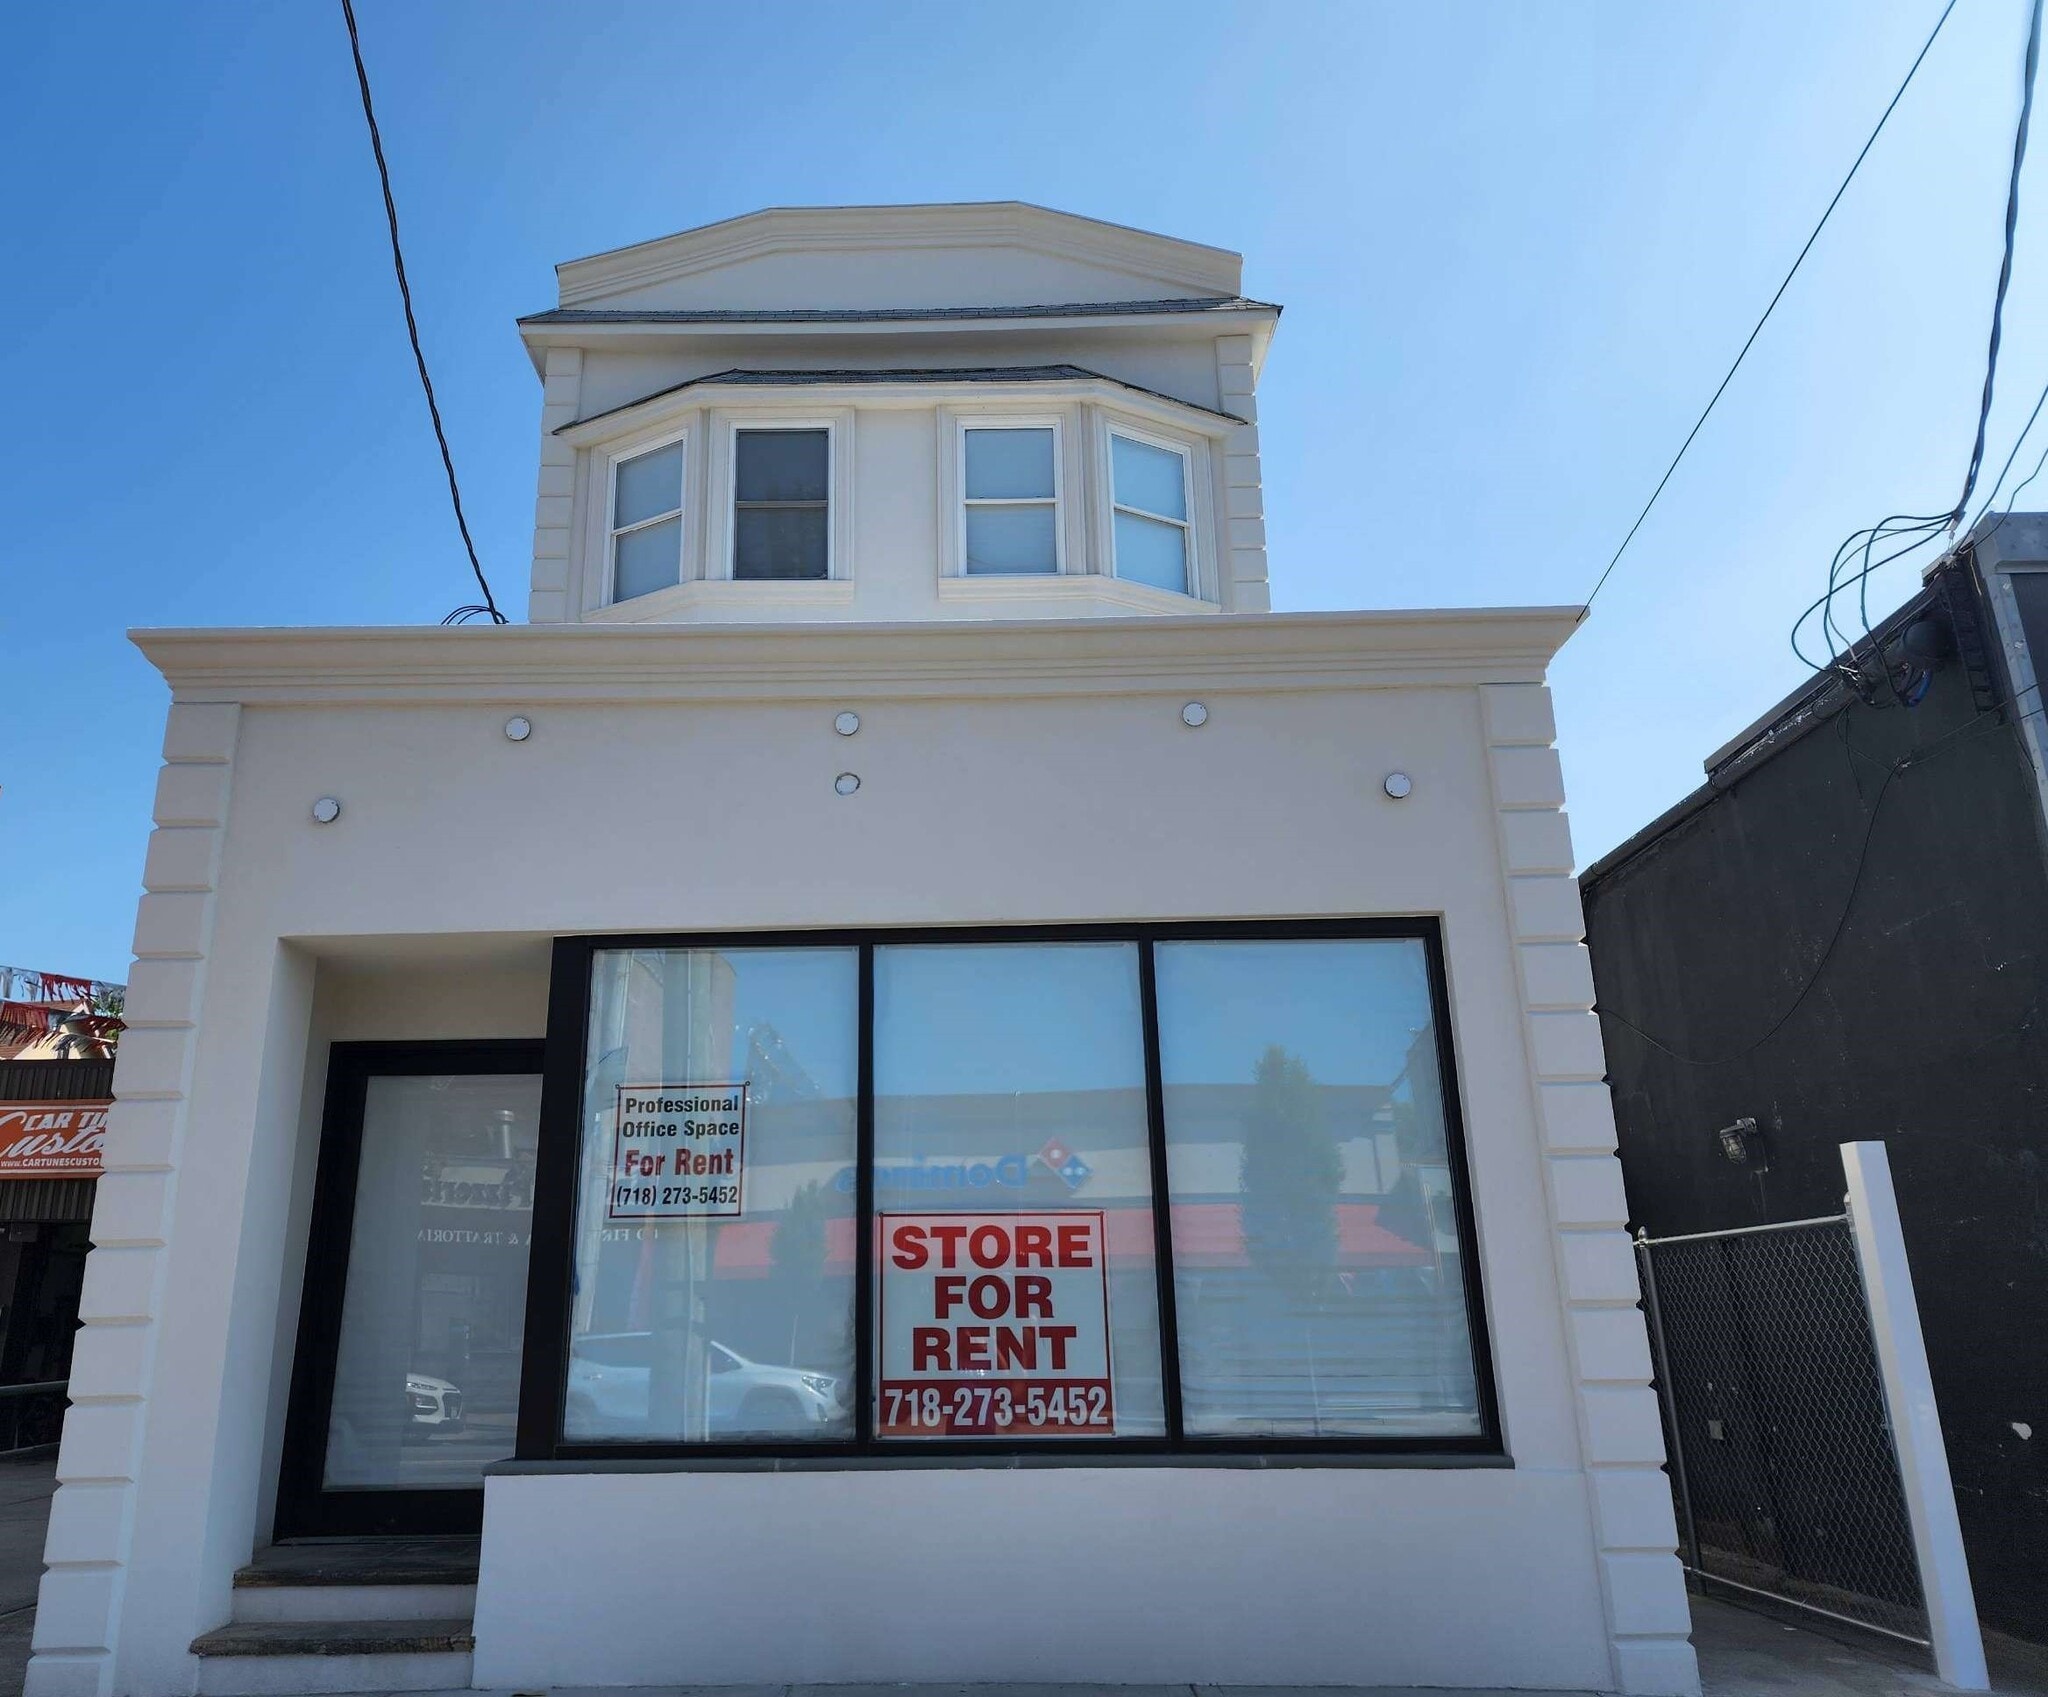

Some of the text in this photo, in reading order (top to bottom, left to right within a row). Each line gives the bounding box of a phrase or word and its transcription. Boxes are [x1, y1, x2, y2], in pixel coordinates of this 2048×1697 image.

[625, 1095, 739, 1114] Professional
[0, 1111, 105, 1158] Custo
[23, 1112, 107, 1131] CAR TU
[622, 1120, 740, 1140] Office Space
[1, 1157, 100, 1168] www.CARTUNESCUSTO
[625, 1148, 734, 1177] For Rent
[617, 1185, 738, 1207] (718) 273-5452
[892, 1225, 1093, 1270] STORE
[934, 1275, 1055, 1319] FOR
[913, 1326, 1077, 1371] RENT
[885, 1386, 1108, 1428] 718-273-5452
